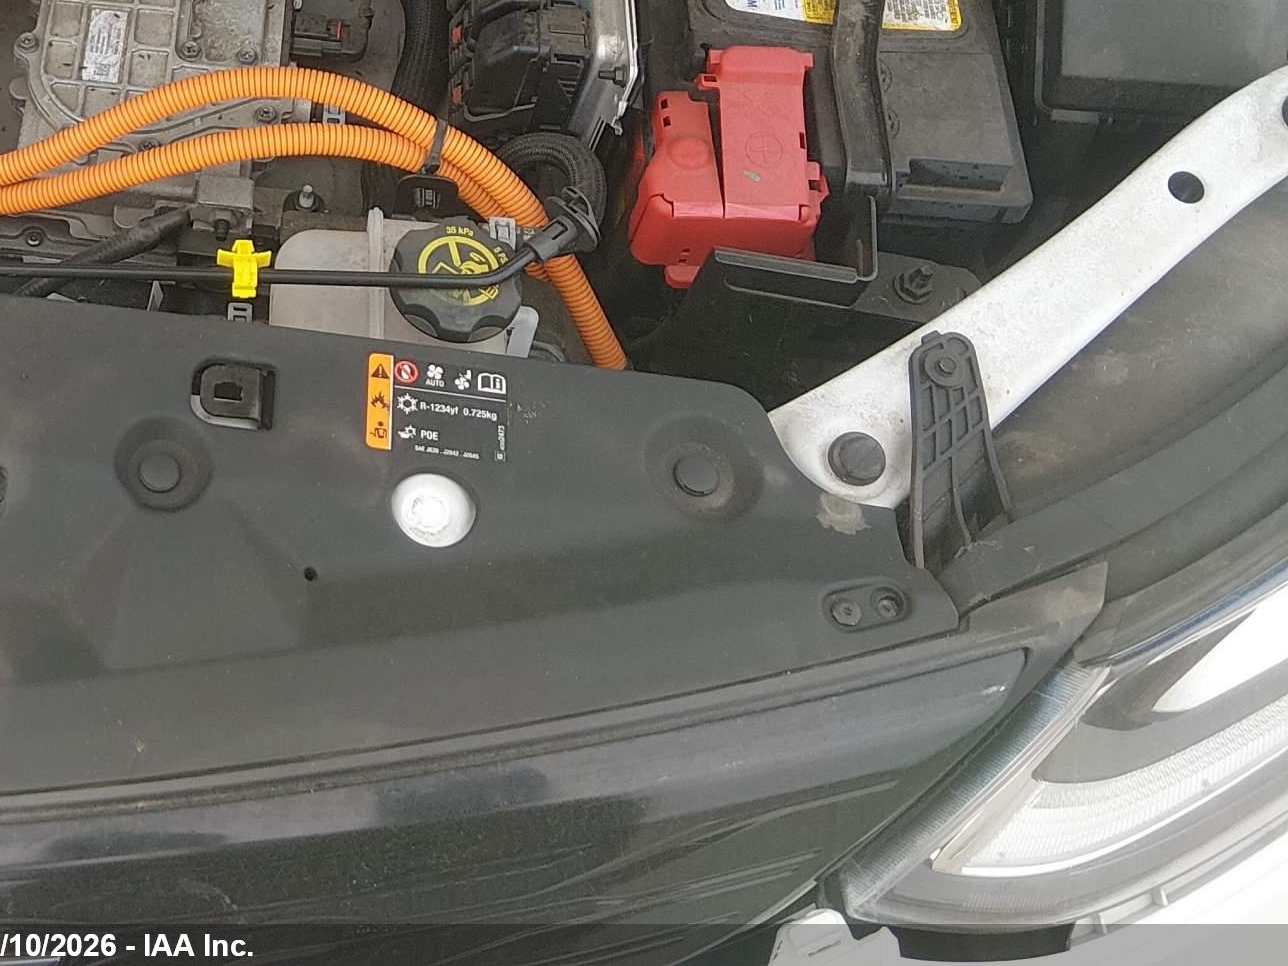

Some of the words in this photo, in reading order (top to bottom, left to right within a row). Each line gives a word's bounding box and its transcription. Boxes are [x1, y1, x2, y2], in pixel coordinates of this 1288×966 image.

[446, 225, 457, 235] 35
[458, 226, 474, 237] kPa
[425, 378, 445, 388] AUTO
[419, 401, 459, 416] R-1234yf
[462, 406, 498, 422] 0.725kg
[420, 429, 439, 441] POE
